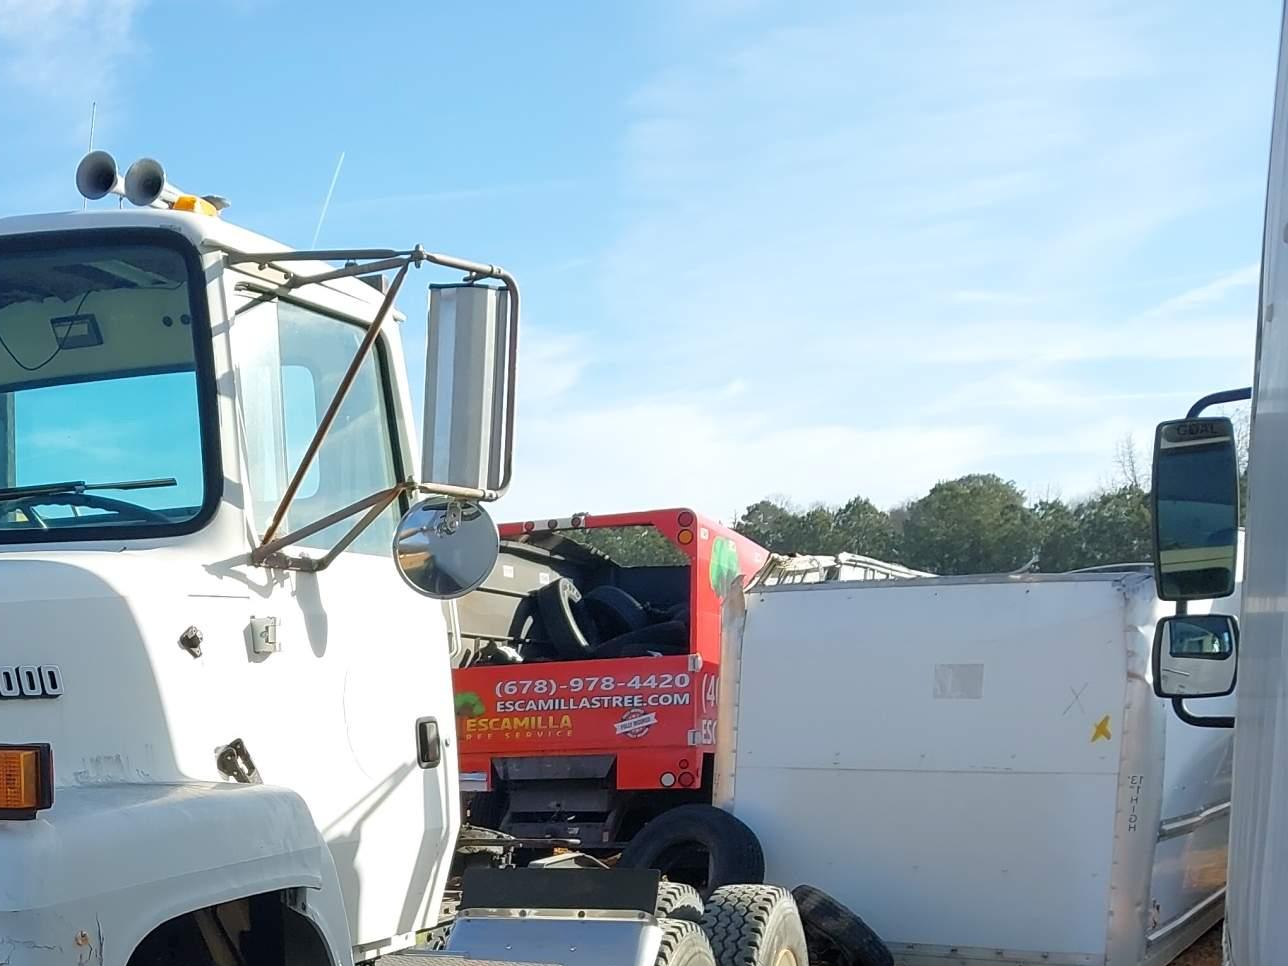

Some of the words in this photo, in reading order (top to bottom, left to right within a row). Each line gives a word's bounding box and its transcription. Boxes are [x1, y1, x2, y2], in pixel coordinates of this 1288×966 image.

[495, 673, 691, 697] (678)-978-4420
[496, 693, 691, 713] ESCAMILLASTREE.COM
[466, 714, 573, 732] ESCAMILLA
